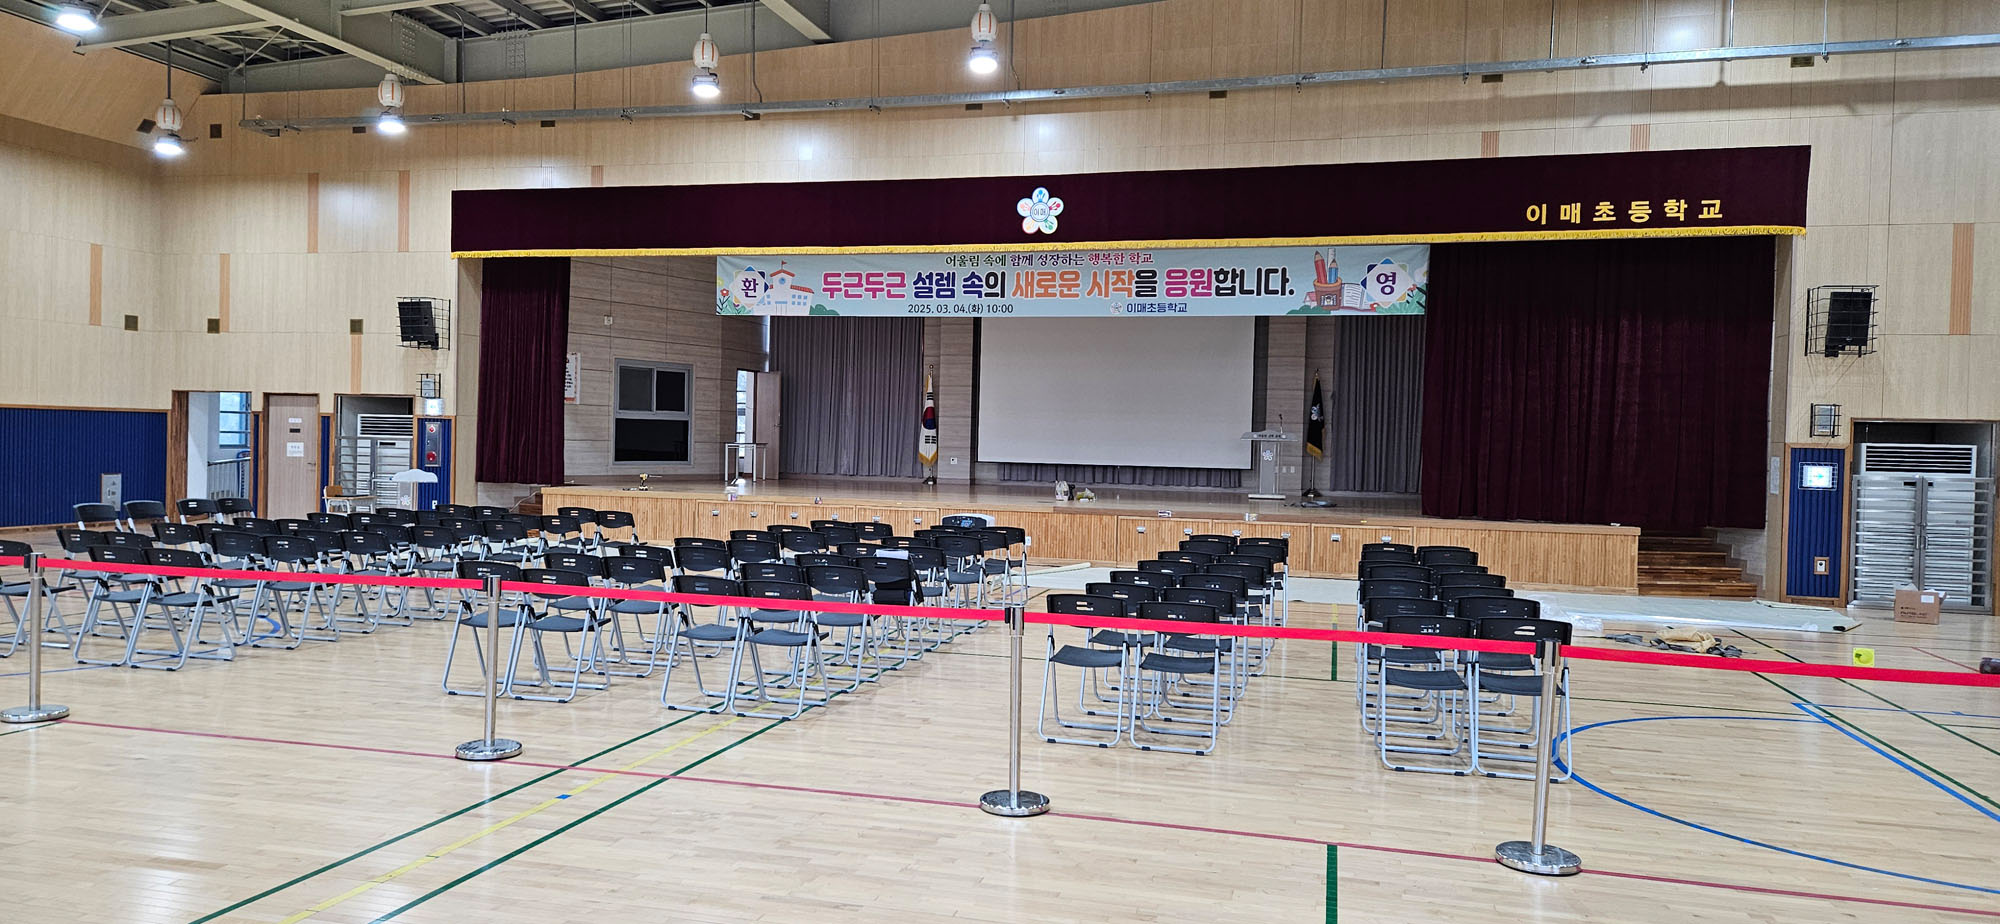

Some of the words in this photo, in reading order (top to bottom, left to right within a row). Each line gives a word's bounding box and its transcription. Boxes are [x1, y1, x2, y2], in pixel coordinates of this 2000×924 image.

[945, 254, 980, 267] 어울림
[983, 254, 1007, 267] 속에
[1010, 254, 1034, 267] 함께
[1037, 253, 1085, 266] 성장하는
[1088, 252, 1125, 266] 행복한
[1129, 252, 1154, 265] 학교
[741, 277, 759, 299] 환
[822, 272, 907, 299] 두근두근
[912, 271, 956, 299] 설렘
[962, 271, 1006, 299] 속의
[1012, 270, 1081, 298] 새로운
[1086, 269, 1158, 298] 시작을
[1165, 267, 1295, 297] 응원합니다.
[1375, 271, 1397, 295] 영
[907, 304, 934, 314] 2025.
[936, 304, 951, 314] 03.
[986, 304, 1014, 314] 10:00
[1126, 302, 1188, 313] 이매초등학교
